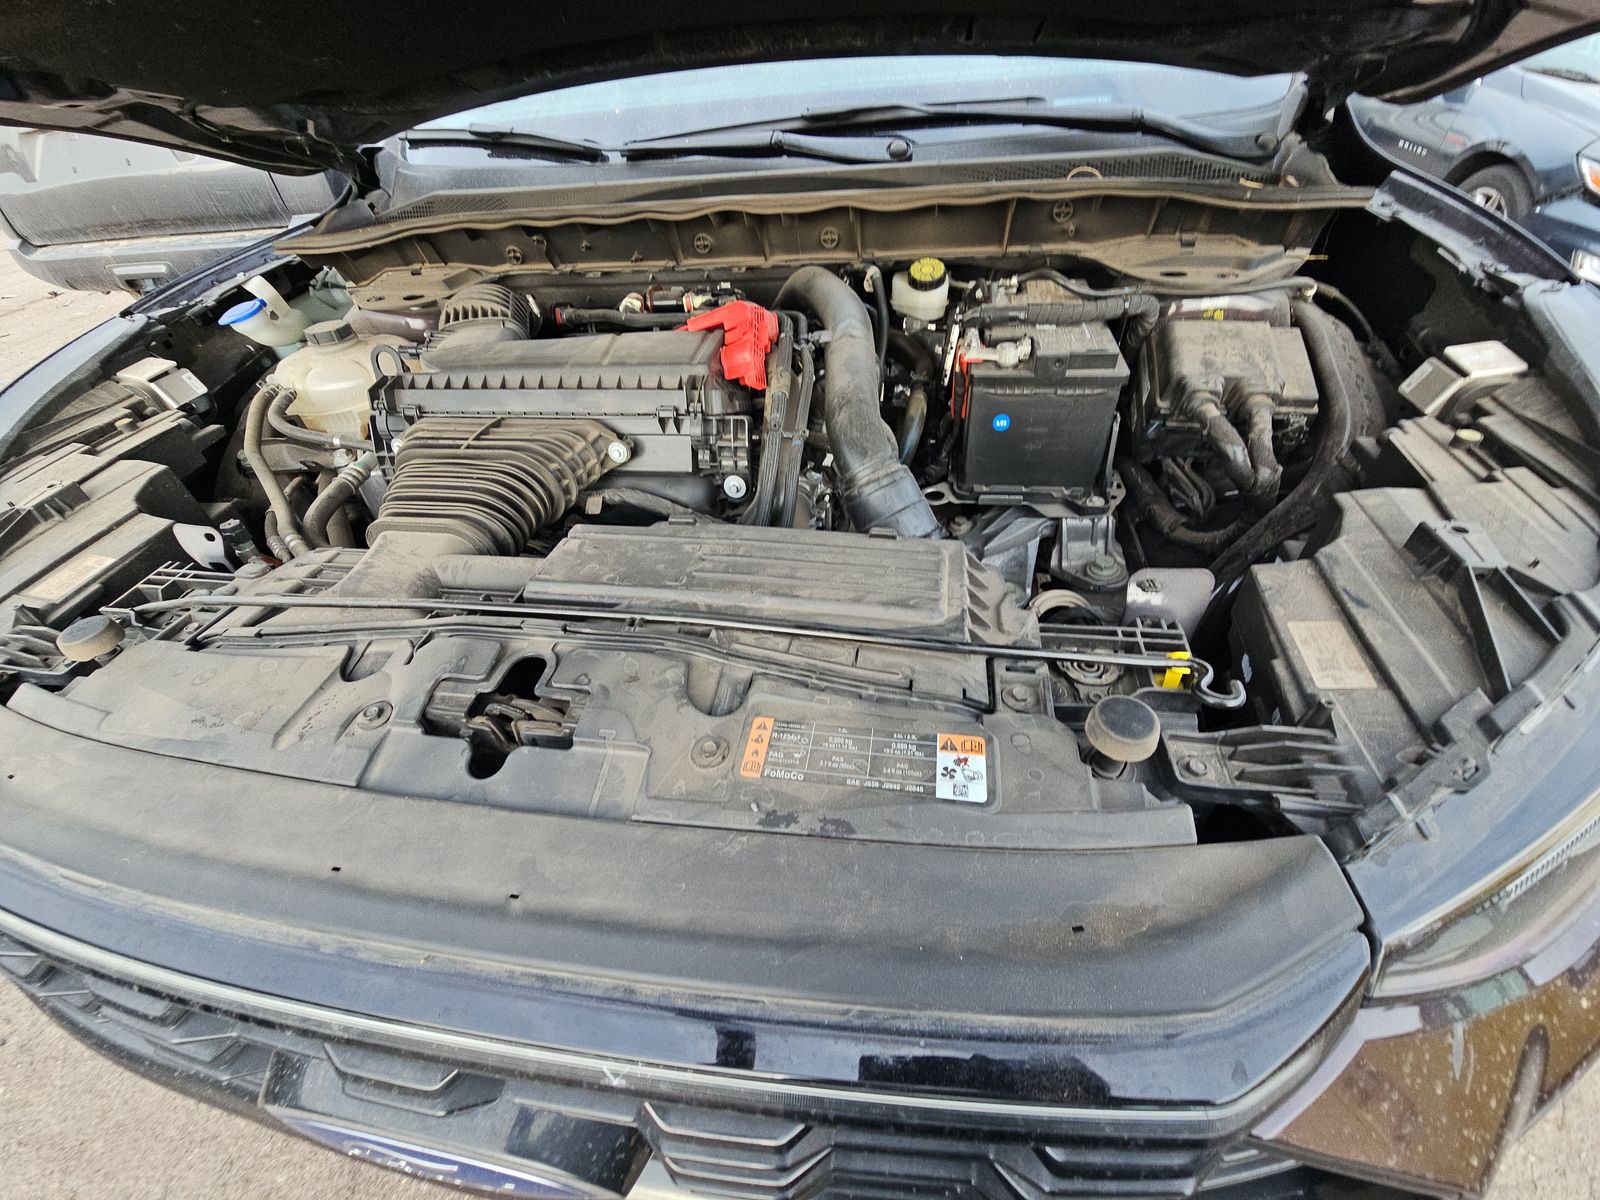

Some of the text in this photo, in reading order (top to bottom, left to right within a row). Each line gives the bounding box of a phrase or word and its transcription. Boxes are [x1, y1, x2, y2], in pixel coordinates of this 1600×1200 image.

[772, 731, 801, 743] R-1234yf
[768, 750, 784, 759] PAG
[831, 755, 844, 763] PAG
[896, 762, 909, 770] PAG
[764, 767, 804, 781] FoMoCo
[846, 777, 861, 786] SAE
